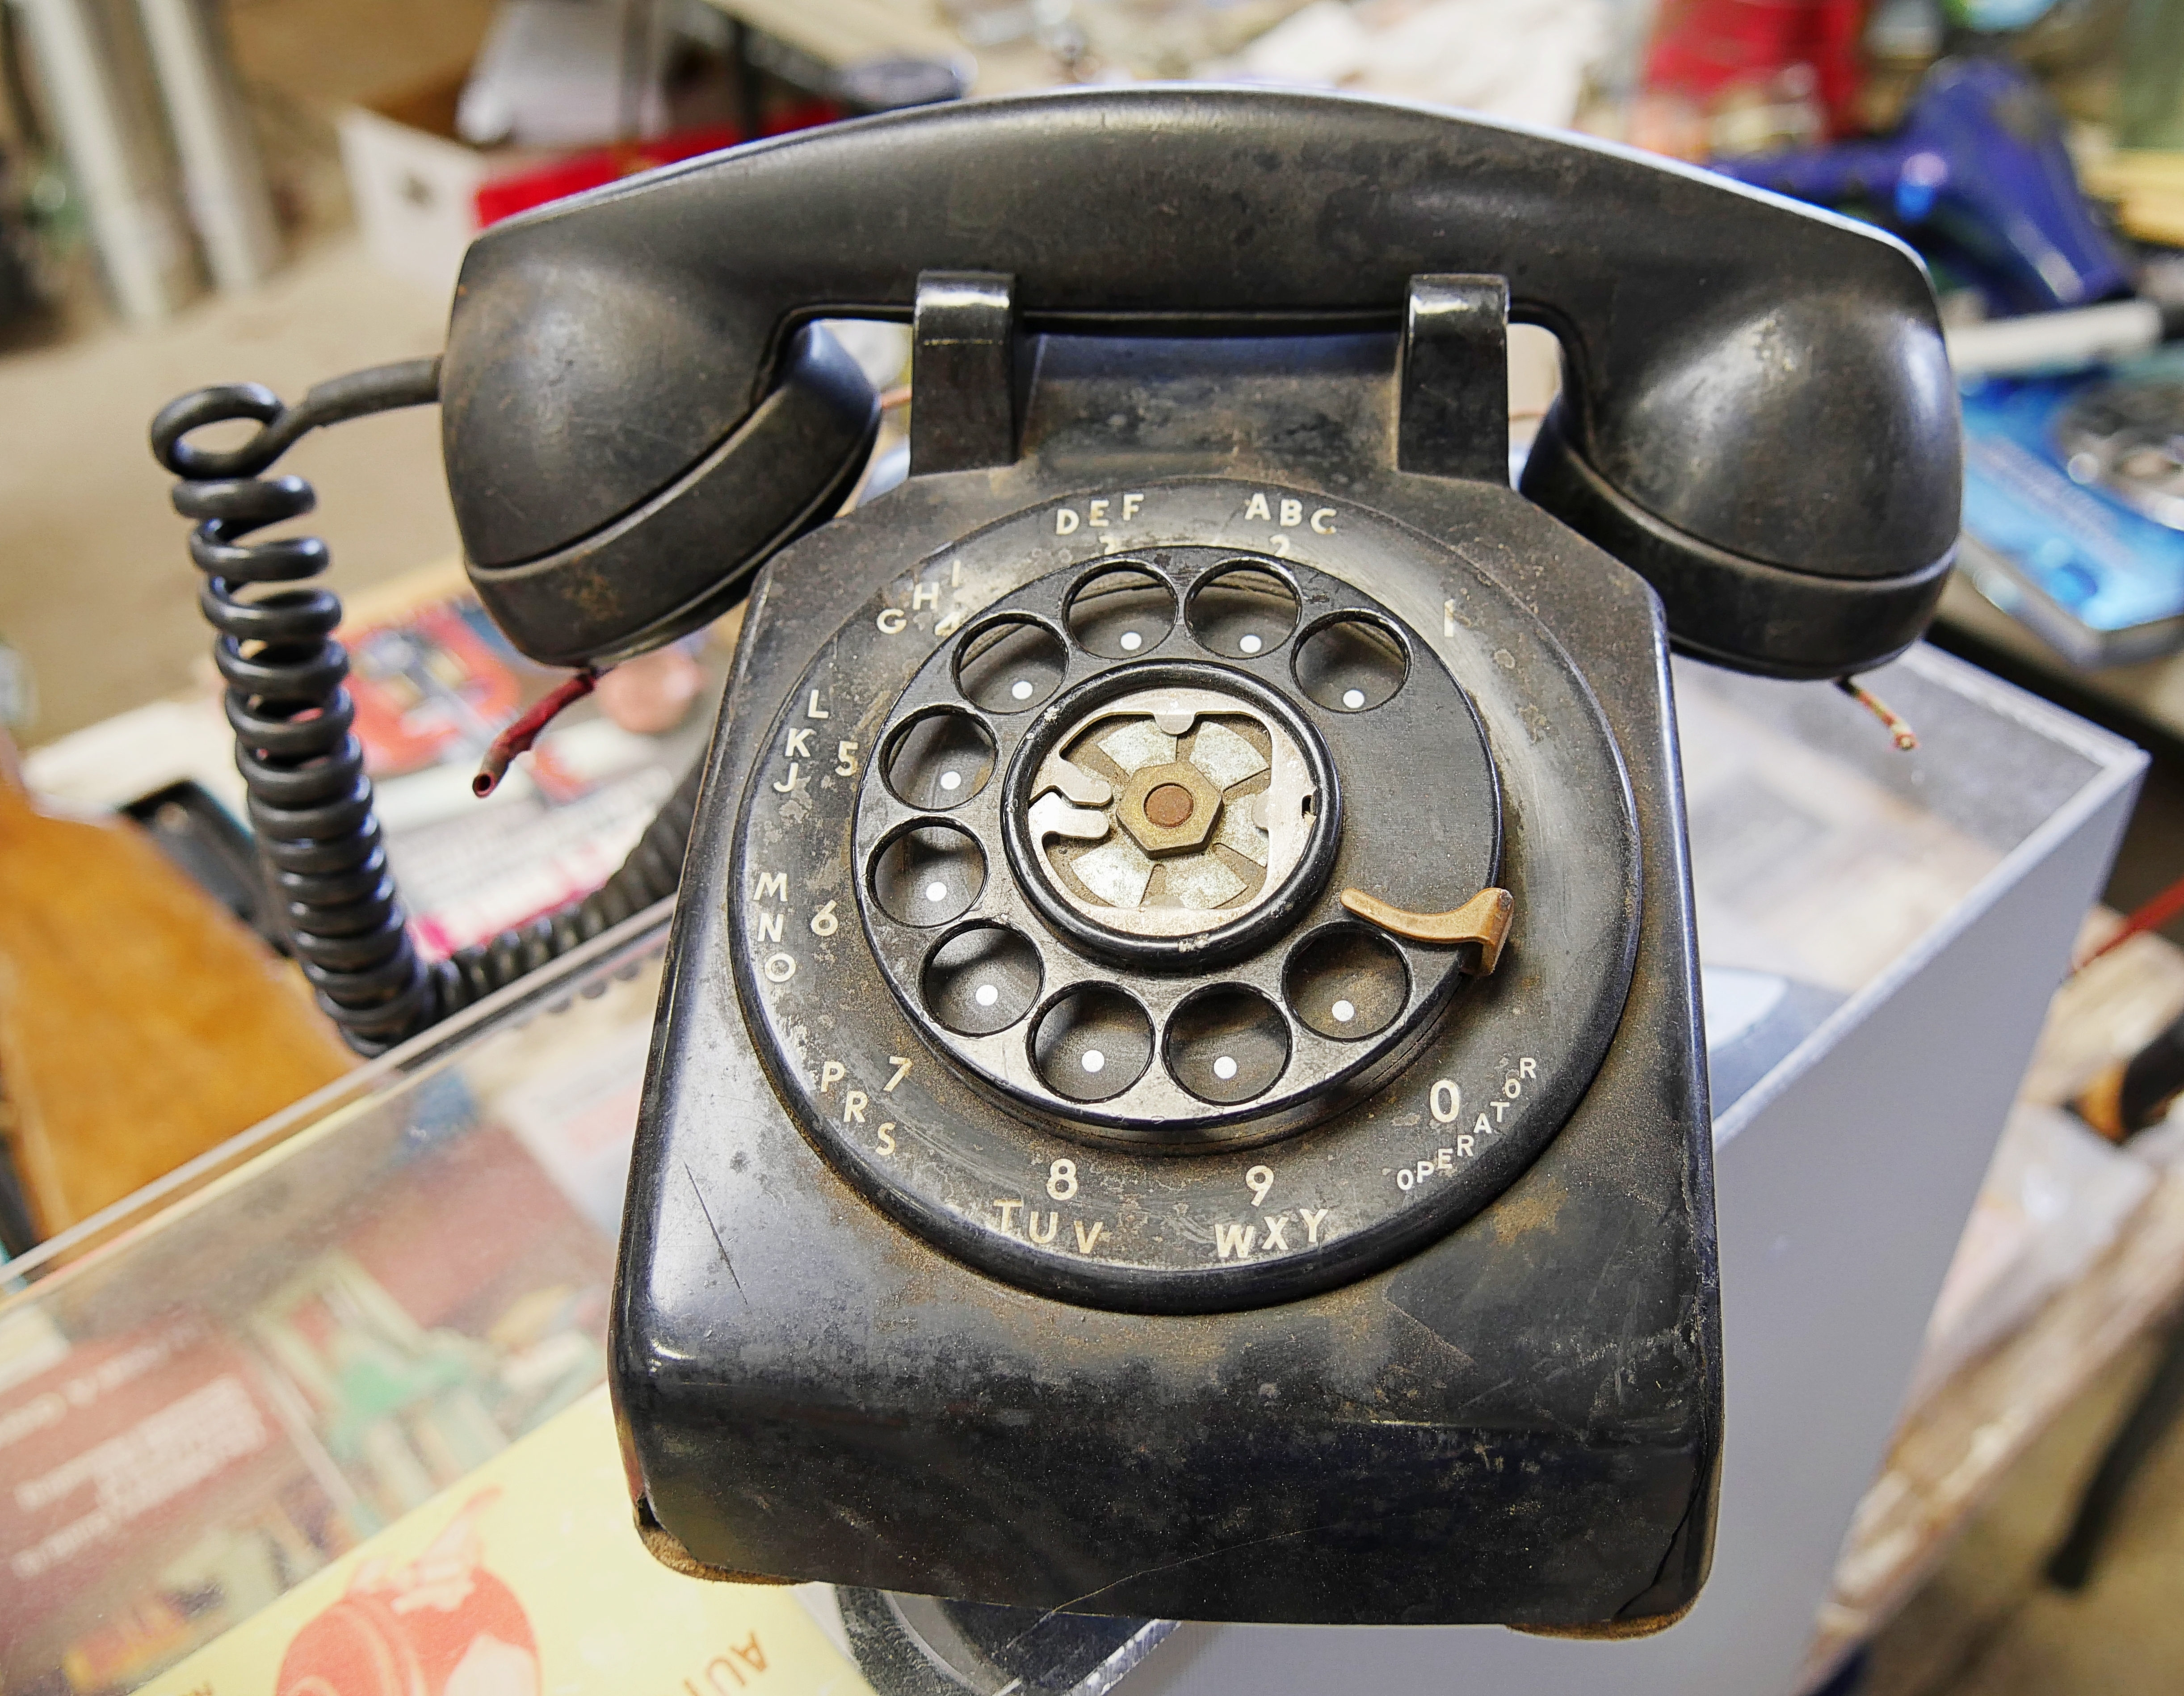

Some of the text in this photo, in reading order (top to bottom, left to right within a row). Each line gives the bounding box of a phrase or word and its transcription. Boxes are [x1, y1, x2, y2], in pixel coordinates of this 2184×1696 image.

[1056, 493, 1144, 535] DEF
[1244, 492, 1337, 534] ABC
[1270, 534, 1290, 557] 2
[877, 560, 961, 635] GHI
[835, 741, 858, 776] 5
[753, 872, 796, 983] MNO
[811, 900, 838, 936] 6
[883, 1056, 913, 1092] 7
[820, 1061, 896, 1155] PRS
[1430, 1079, 1460, 1123] 0
[1397, 1057, 1537, 1191] OPERATOR
[1046, 1158, 1078, 1201] 8
[1245, 1165, 1274, 1207] 9
[993, 1199, 1104, 1254] TUV
[1214, 1208, 1329, 1258] WXY
